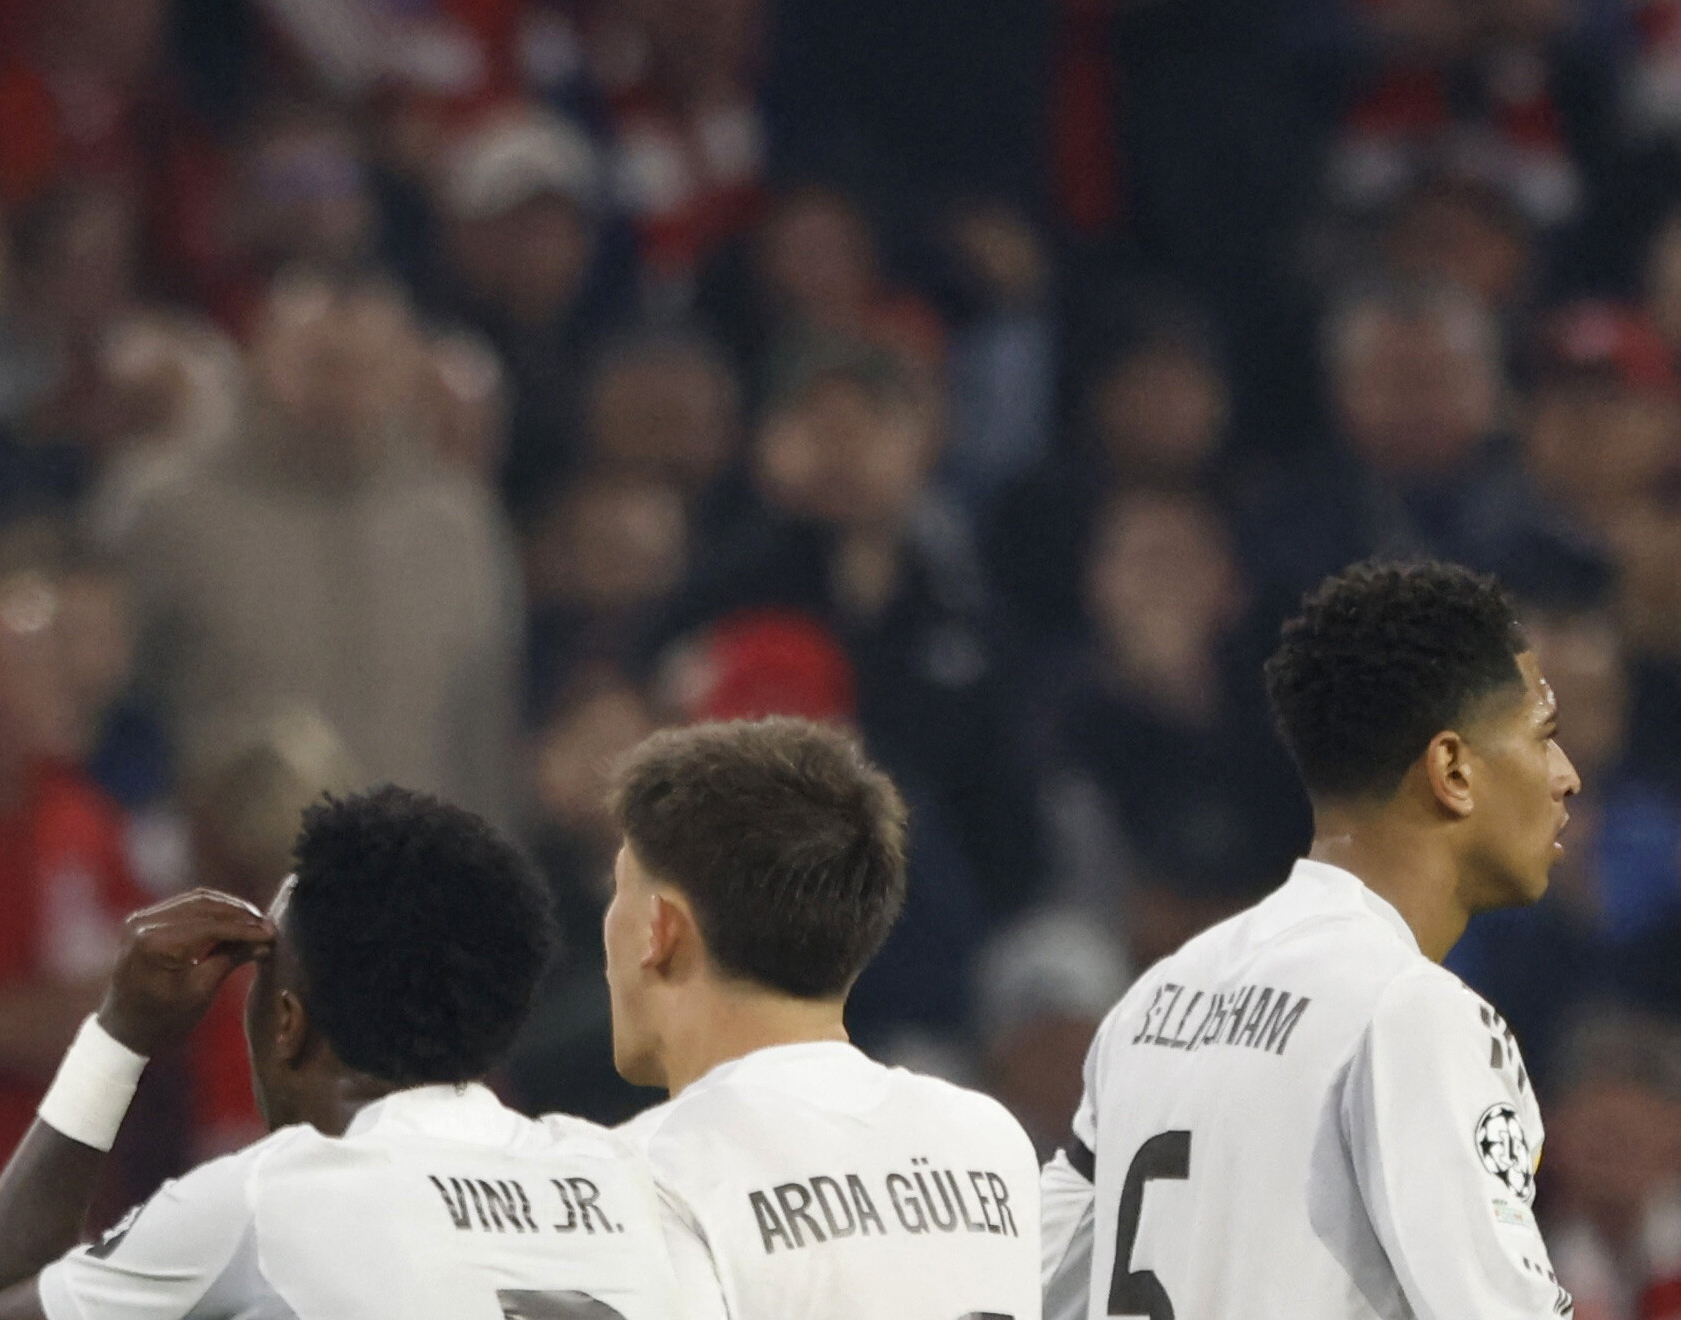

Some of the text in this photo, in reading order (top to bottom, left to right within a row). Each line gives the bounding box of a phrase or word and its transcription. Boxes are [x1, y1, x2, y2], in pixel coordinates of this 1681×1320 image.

[430, 1173, 625, 1236] VINI JR.
[748, 1156, 1019, 1256] ARDA GÜLER
